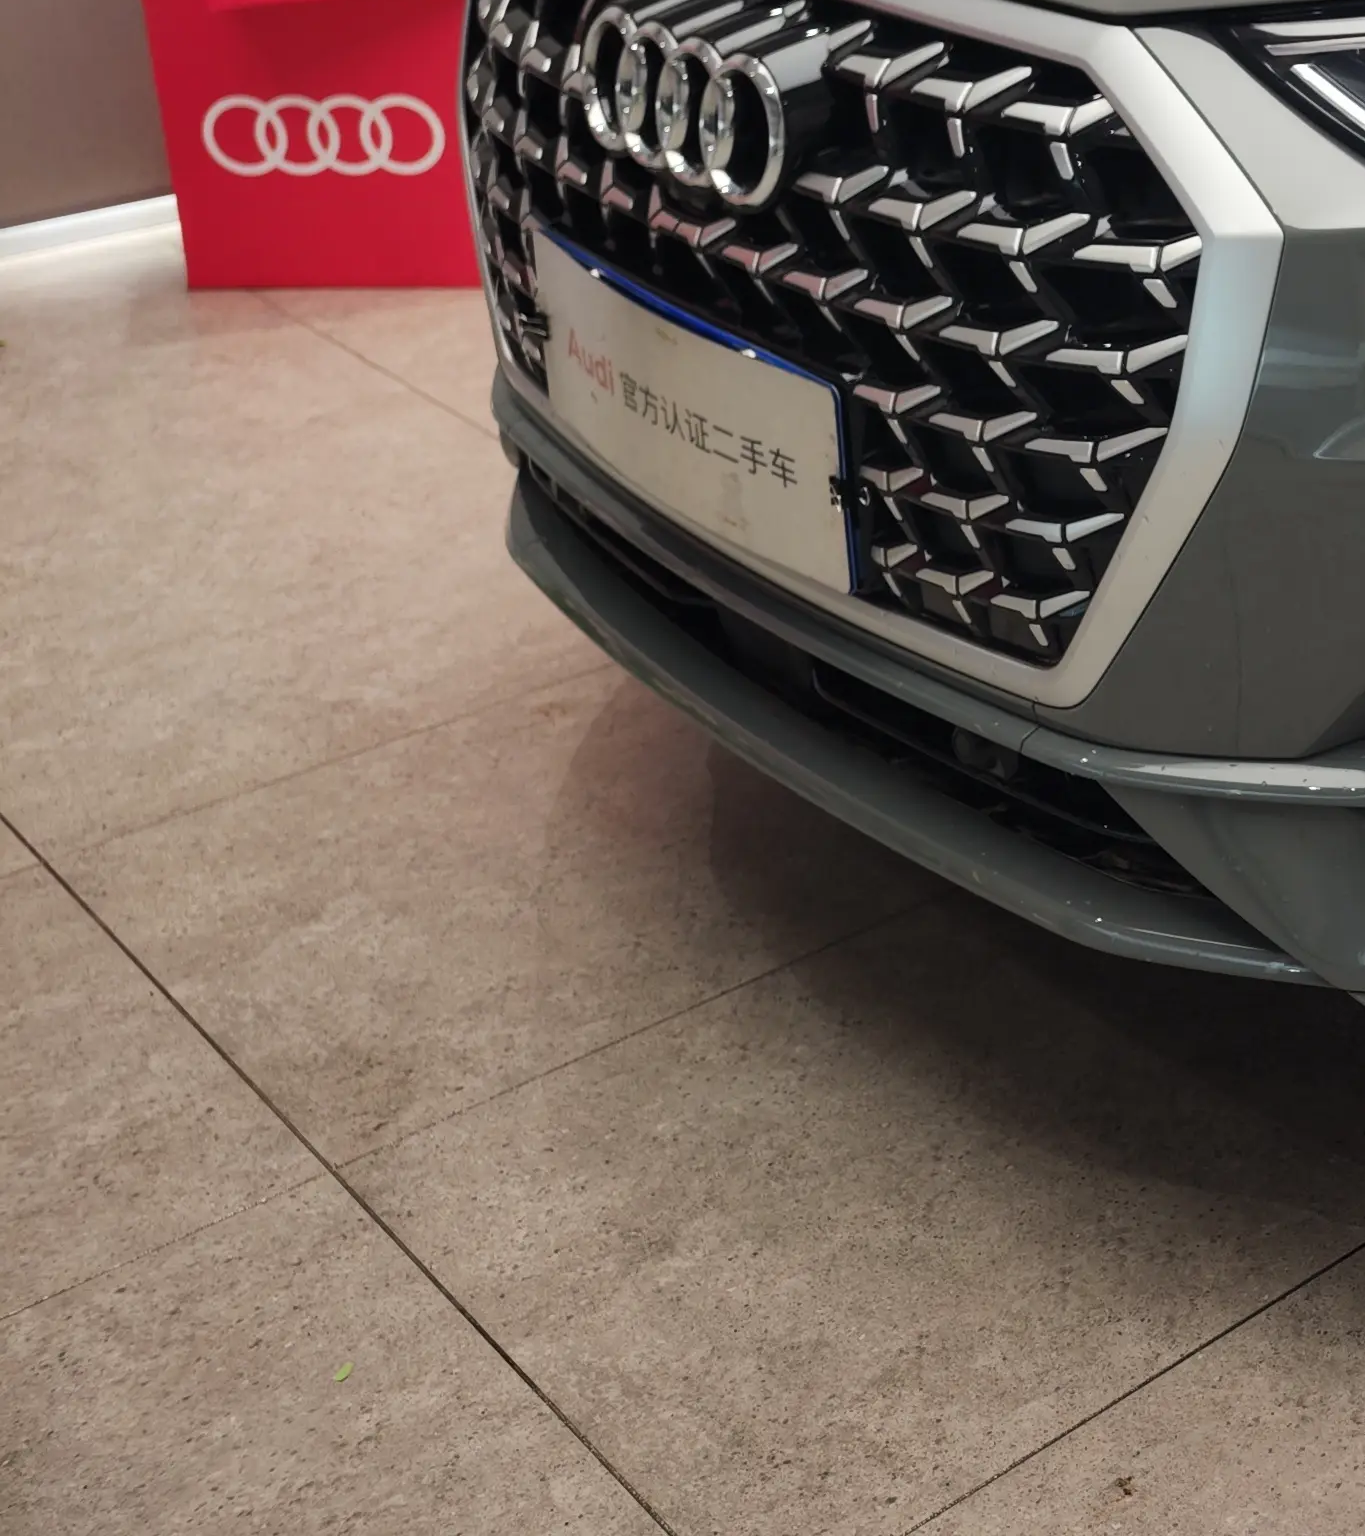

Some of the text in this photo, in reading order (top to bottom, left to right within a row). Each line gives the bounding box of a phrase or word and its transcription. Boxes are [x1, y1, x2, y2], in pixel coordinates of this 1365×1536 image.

[568, 327, 798, 488] Audi 官方认证二手车
